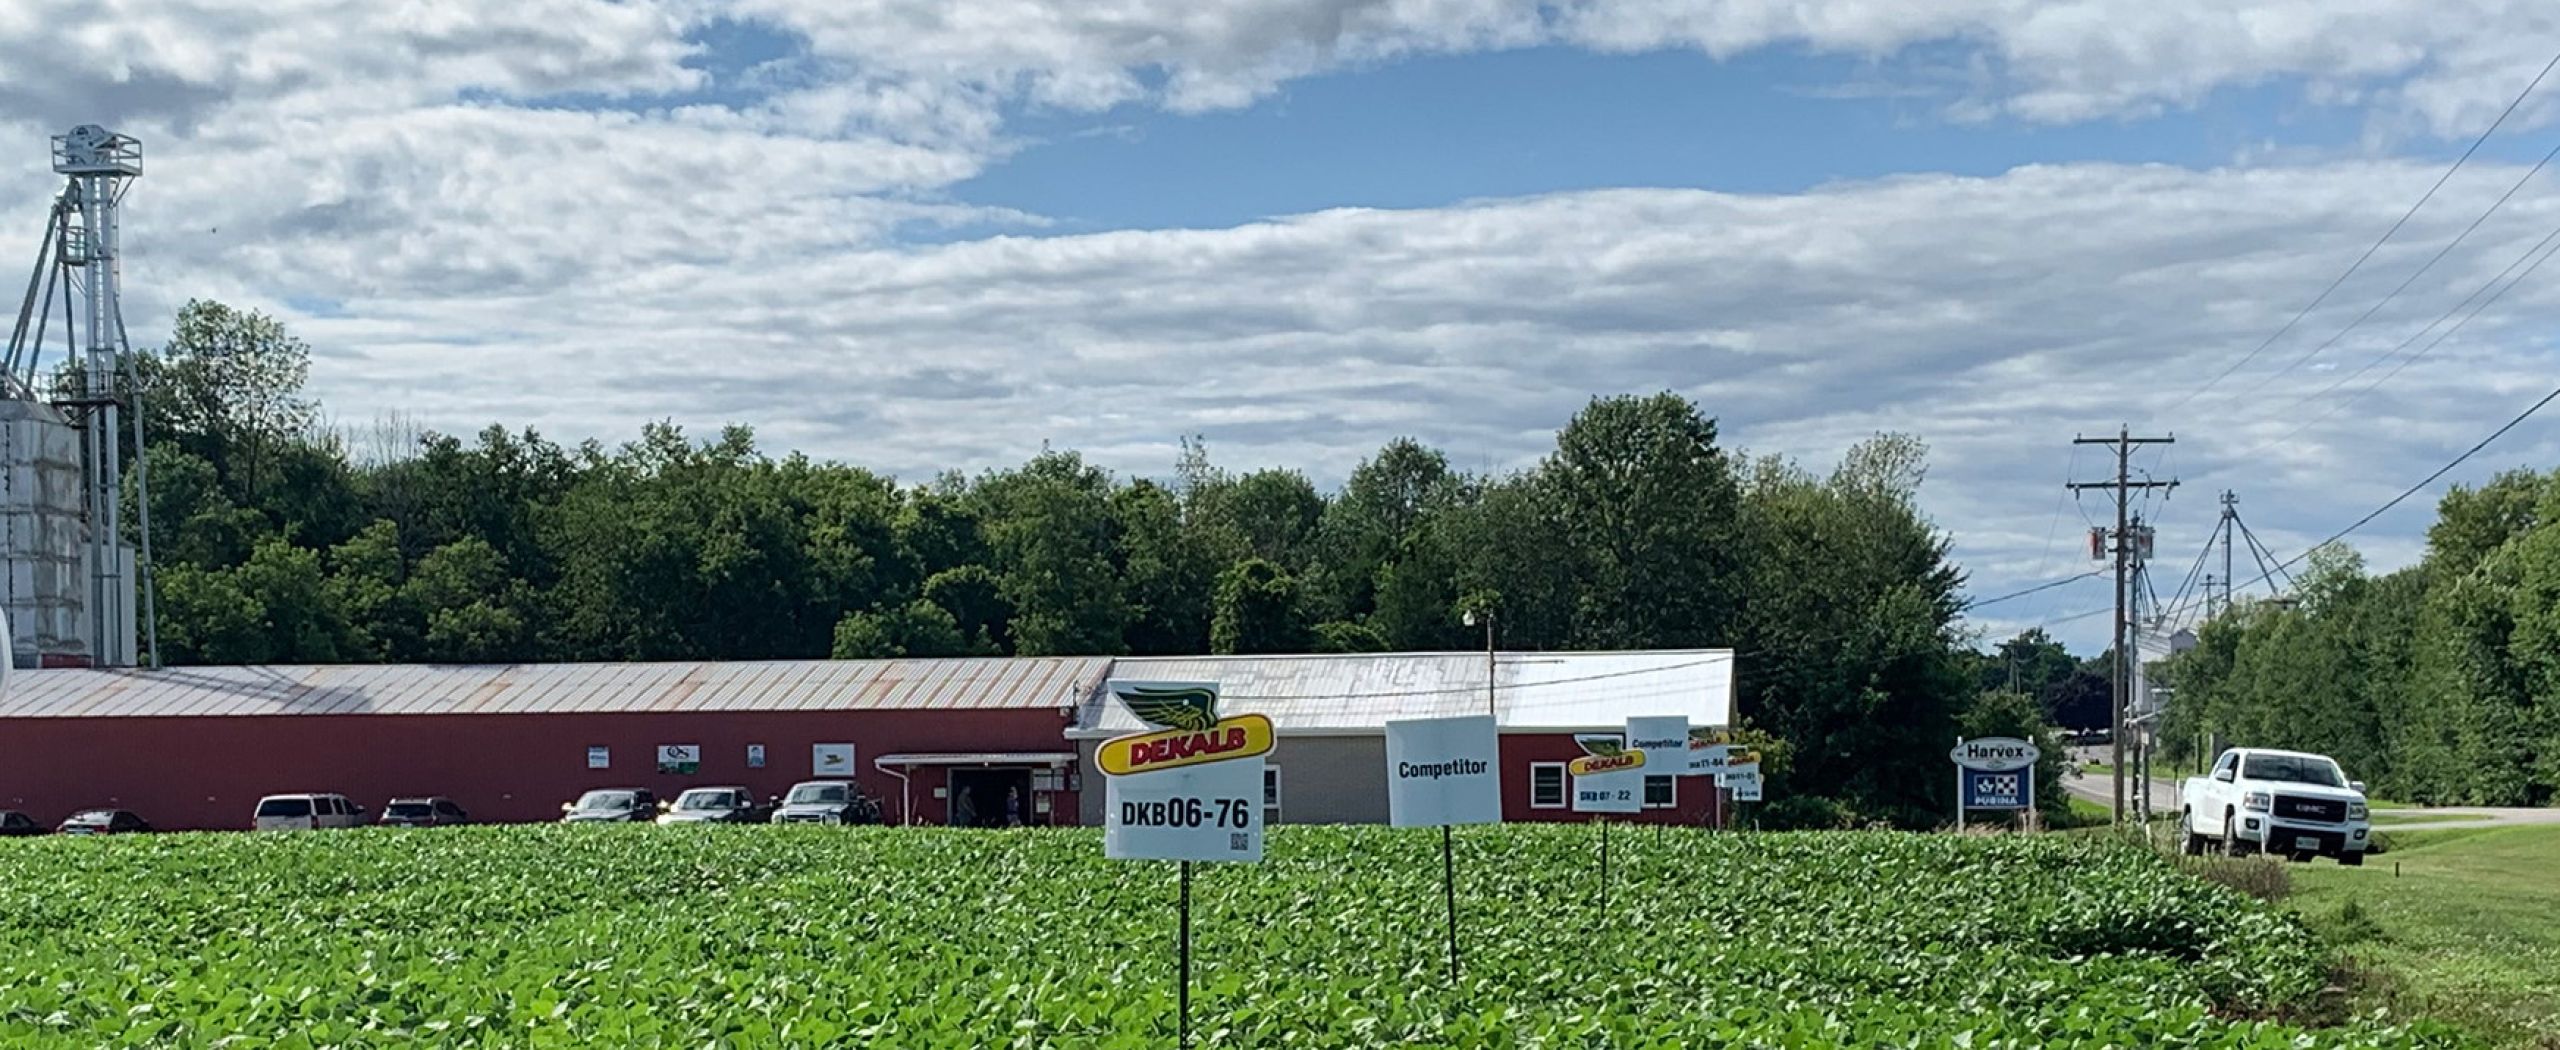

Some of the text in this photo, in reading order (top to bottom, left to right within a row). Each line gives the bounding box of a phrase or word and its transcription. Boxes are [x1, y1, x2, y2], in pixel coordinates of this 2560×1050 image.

[1130, 727, 1246, 766] DEKALB
[1632, 739, 1683, 750] Competitor
[1967, 744, 2024, 758] Harvex
[1399, 758, 1488, 780] Competitor
[1584, 755, 1634, 772] DEKALB
[1975, 796, 2018, 805] PURINA
[1121, 797, 1249, 828] DKB06-76
[2296, 803, 2327, 814] GMC
